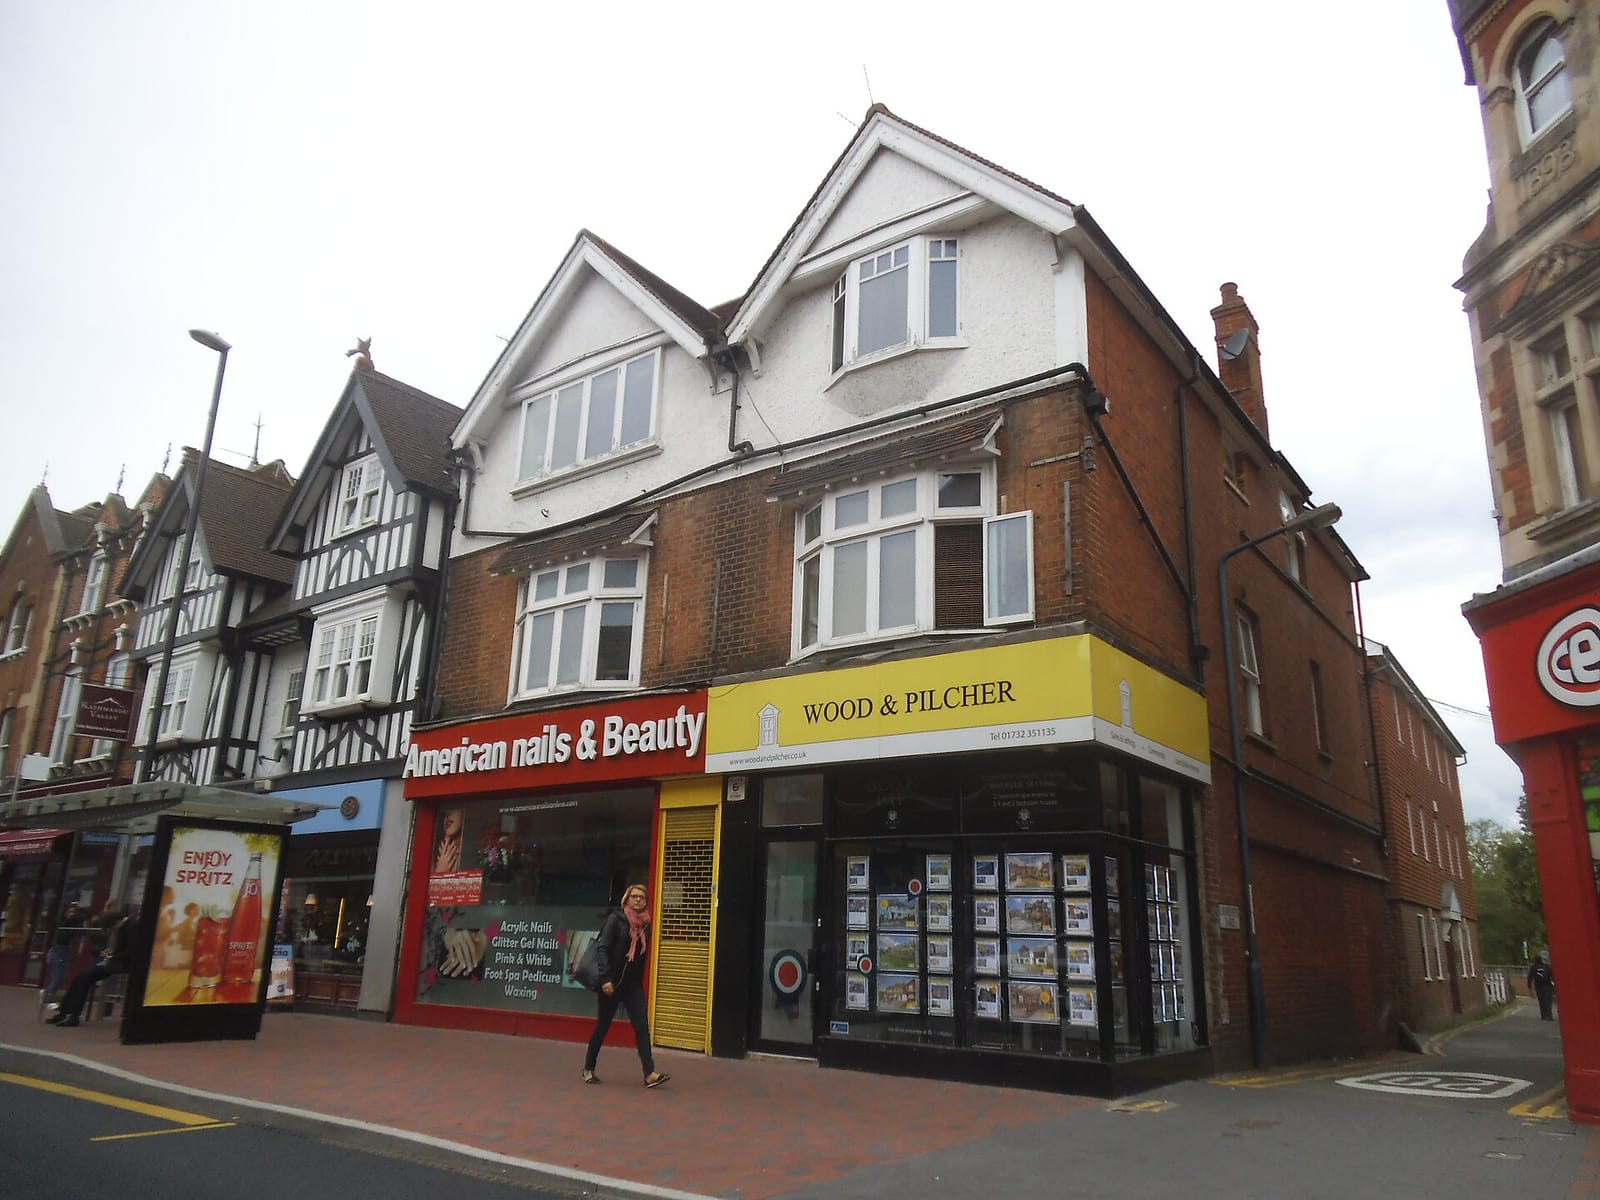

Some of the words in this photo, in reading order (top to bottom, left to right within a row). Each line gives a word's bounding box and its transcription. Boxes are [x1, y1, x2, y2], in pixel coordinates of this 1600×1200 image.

[803, 697, 873, 725] WOOD
[880, 694, 898, 717] &
[905, 680, 1016, 714] PILCHER
[402, 737, 507, 779] American
[511, 725, 571, 768] nails
[576, 719, 597, 761] &
[602, 704, 705, 758] Beauty
[990, 732, 1001, 741] Tel
[1001, 729, 1026, 741] 01732
[1027, 727, 1057, 738] 351135
[729, 751, 808, 766] www.woodandpilcher.co.uk
[183, 850, 233, 870] ENJOY
[500, 920, 529, 935] Acrylic
[530, 921, 553, 934] Nails
[491, 936, 519, 948] Glitter
[520, 936, 535, 949] Gel
[536, 937, 560, 950] Nails
[495, 951, 515, 965] Pink
[516, 953, 524, 965] &
[525, 953, 552, 967] White
[484, 967, 504, 980] Foot
[504, 968, 520, 982] Spa
[522, 969, 561, 984] Pedicure
[504, 984, 538, 1001] Waxing
